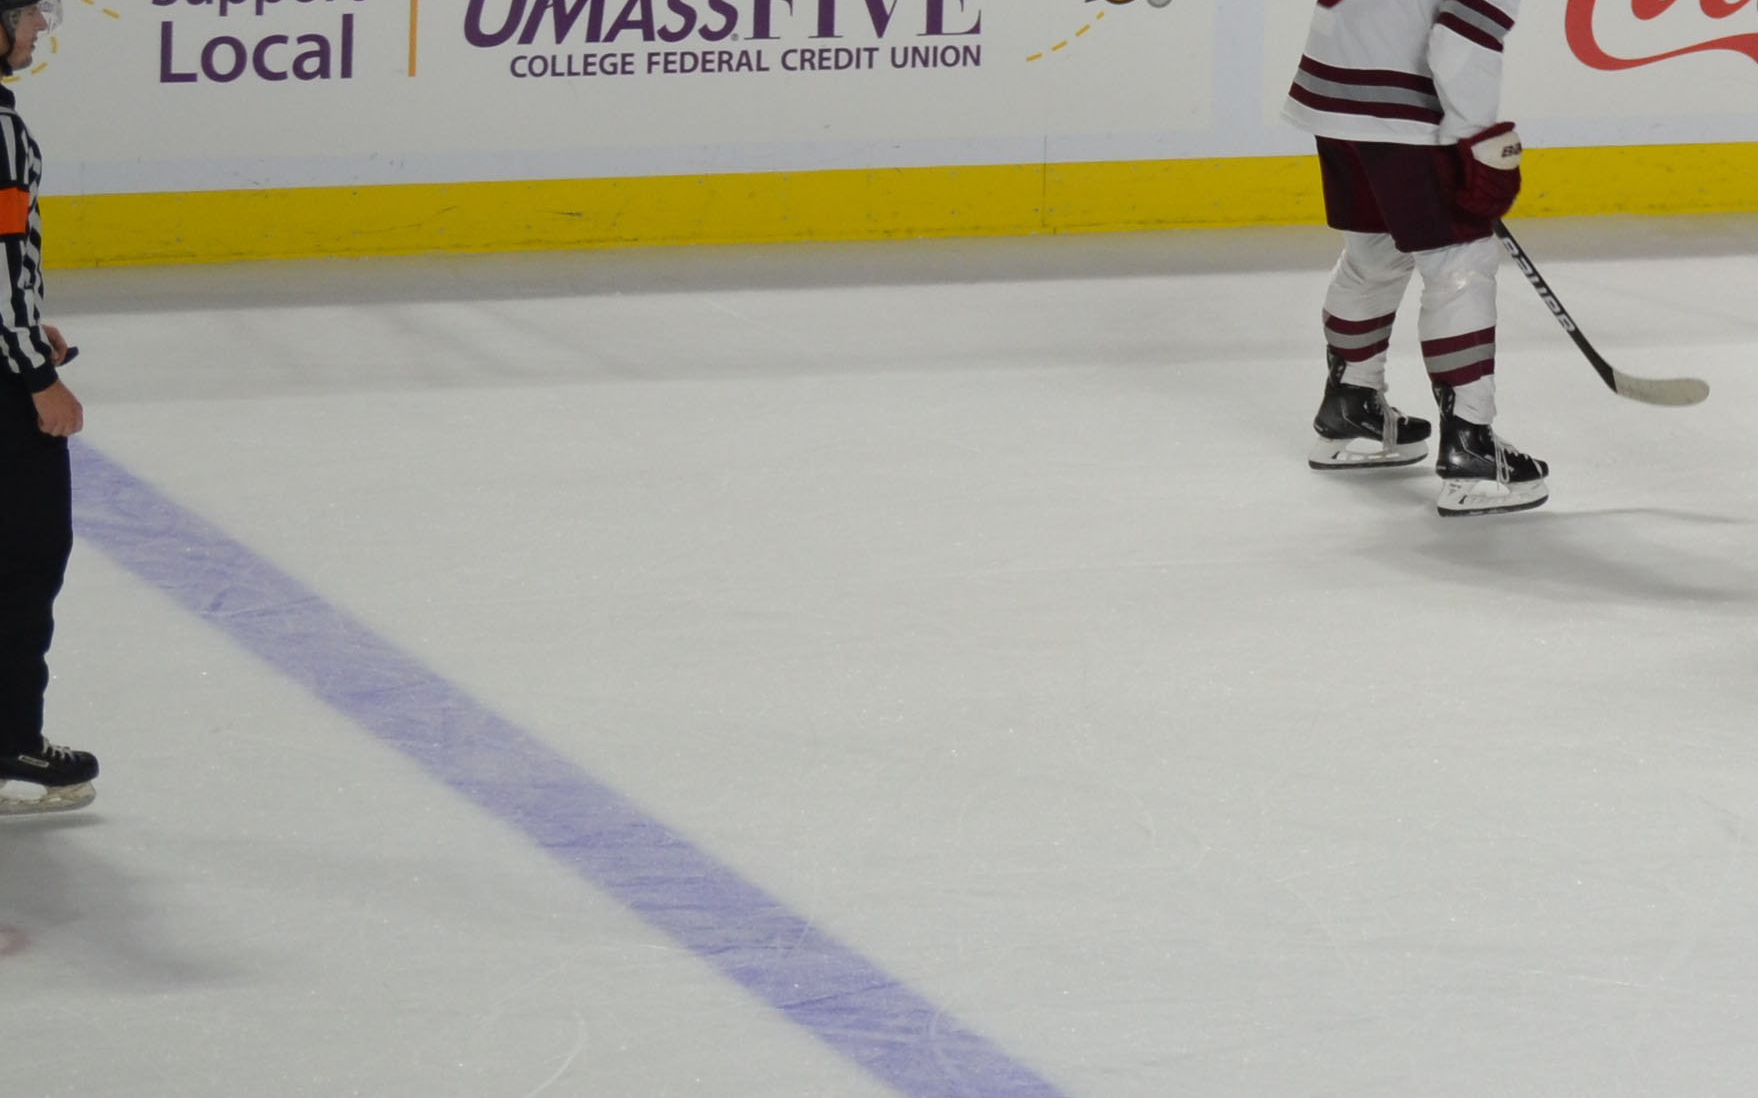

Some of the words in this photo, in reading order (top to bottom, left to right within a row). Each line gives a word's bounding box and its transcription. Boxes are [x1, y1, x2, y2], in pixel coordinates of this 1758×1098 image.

[159, 13, 354, 84] Local
[510, 52, 635, 79] COLLEGE
[646, 49, 770, 75] FEDERAL
[781, 47, 879, 73] CREDIT
[890, 44, 982, 70] UNION
